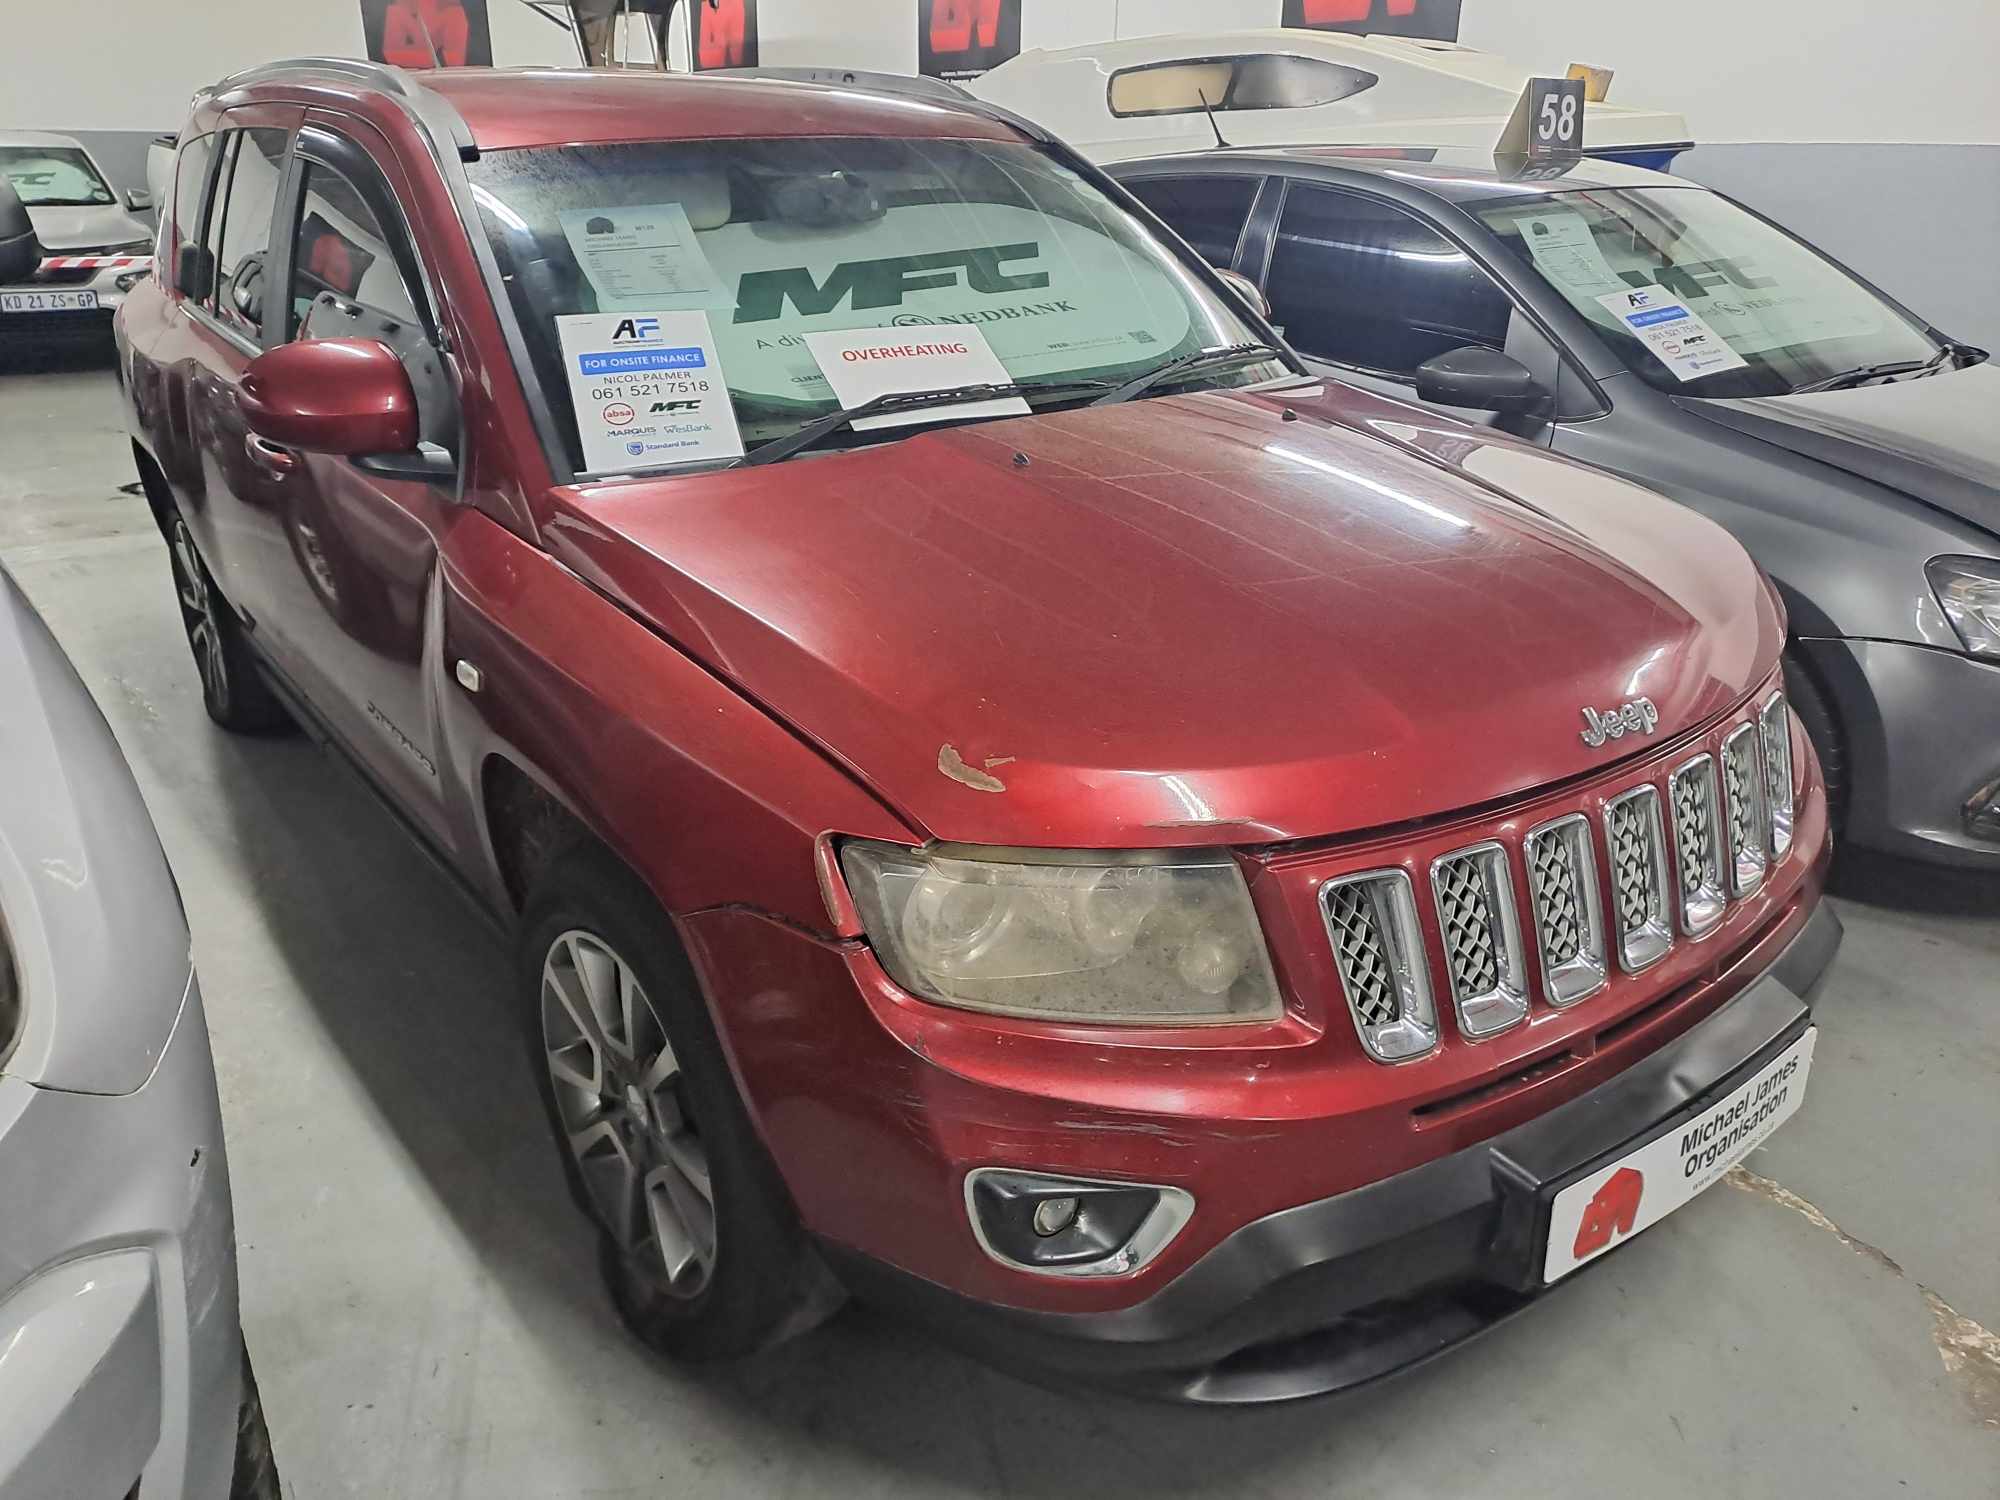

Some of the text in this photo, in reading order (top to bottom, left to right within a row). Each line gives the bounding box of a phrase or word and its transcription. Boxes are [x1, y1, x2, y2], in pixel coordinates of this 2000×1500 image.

[1538, 93, 1577, 141] 58
[732, 241, 1050, 324] MFC
[28, 295, 44, 309] 21
[77, 293, 94, 307] GP
[612, 318, 660, 340] AF
[756, 339, 773, 350] A
[939, 299, 1078, 324] NEDBANK
[584, 353, 700, 369] FOR ONSITE FINANCE
[841, 342, 969, 362] OVERHEATING
[603, 371, 691, 385] NICOL PALMER
[592, 380, 710, 400] 061 521 7518
[605, 409, 631, 418] absa
[649, 400, 702, 413] MFC
[607, 426, 657, 437] MARQUIS
[645, 439, 700, 451] Standard Bank
[1580, 696, 1659, 748] Jeep
[1680, 1091, 1751, 1157] Michael
[1752, 1055, 1799, 1107] James
[1684, 1086, 1788, 1178] Organisation
